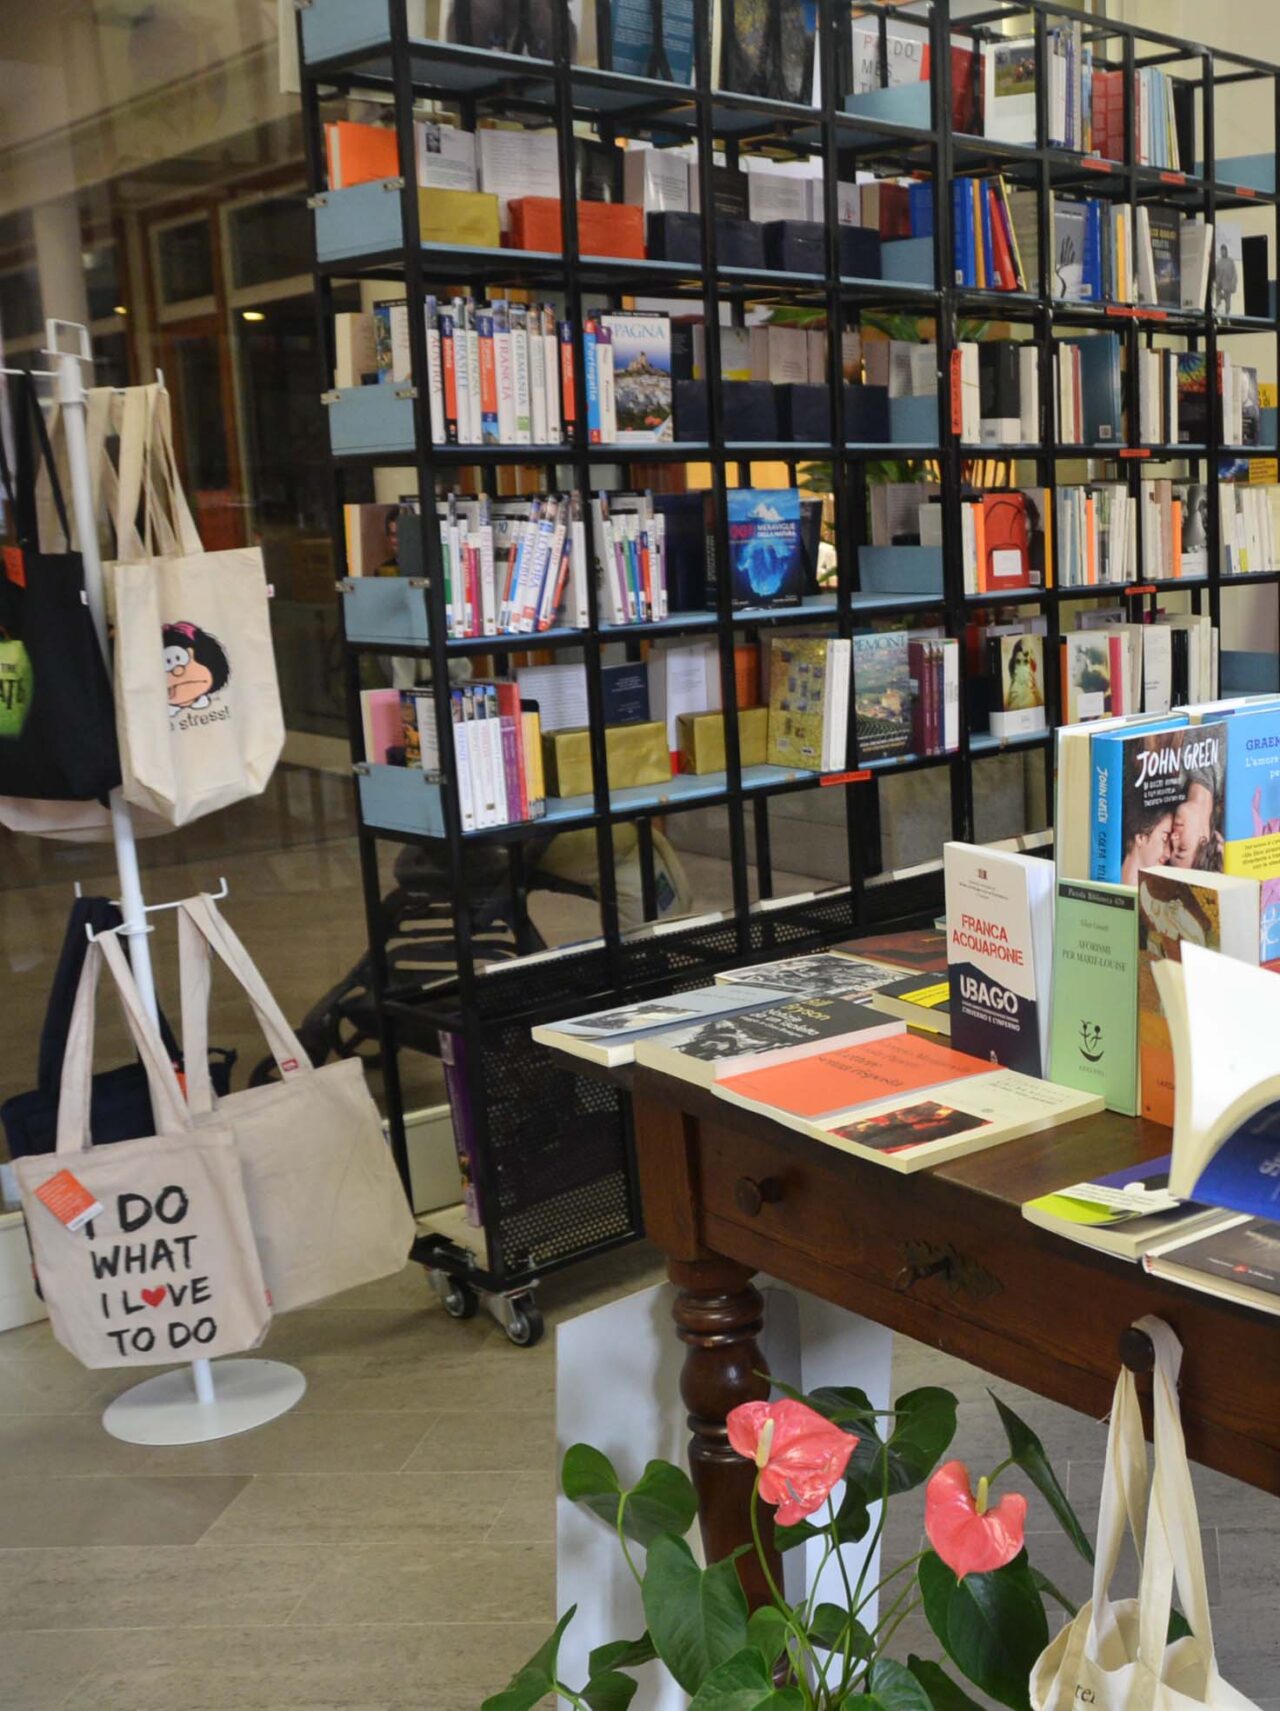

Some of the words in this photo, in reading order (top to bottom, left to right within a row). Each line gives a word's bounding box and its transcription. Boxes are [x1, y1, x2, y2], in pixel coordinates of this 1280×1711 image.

[614, 322, 665, 340] PAGNA
[500, 338, 513, 401] FRANCIA
[516, 333, 527, 406] GERMANIA
[587, 340, 598, 401] Portogallo
[528, 531, 549, 590] LONDRA
[179, 706, 231, 732] stress!
[1134, 747, 1181, 788] JOHN
[1183, 737, 1220, 771] GREEN
[1245, 755, 1279, 768] L'amore
[1096, 766, 1109, 798] JOHN
[1096, 798, 1108, 824] GREEN
[1067, 887, 1086, 899] Piccola
[1087, 891, 1113, 905] Biblioteca
[961, 913, 1009, 943] FRANCA
[952, 929, 1024, 966] ACQUARONE
[1062, 948, 1075, 960] PER
[1076, 953, 1128, 972] MARIE-LOUISE
[1079, 940, 1112, 955] AFORISMI
[959, 973, 1019, 1015] UBAGO
[117, 1185, 189, 1233] DO
[91, 1235, 198, 1280] WHAT
[102, 1292, 110, 1319] I
[107, 1327, 156, 1357] TO
[168, 1317, 218, 1349] DO
